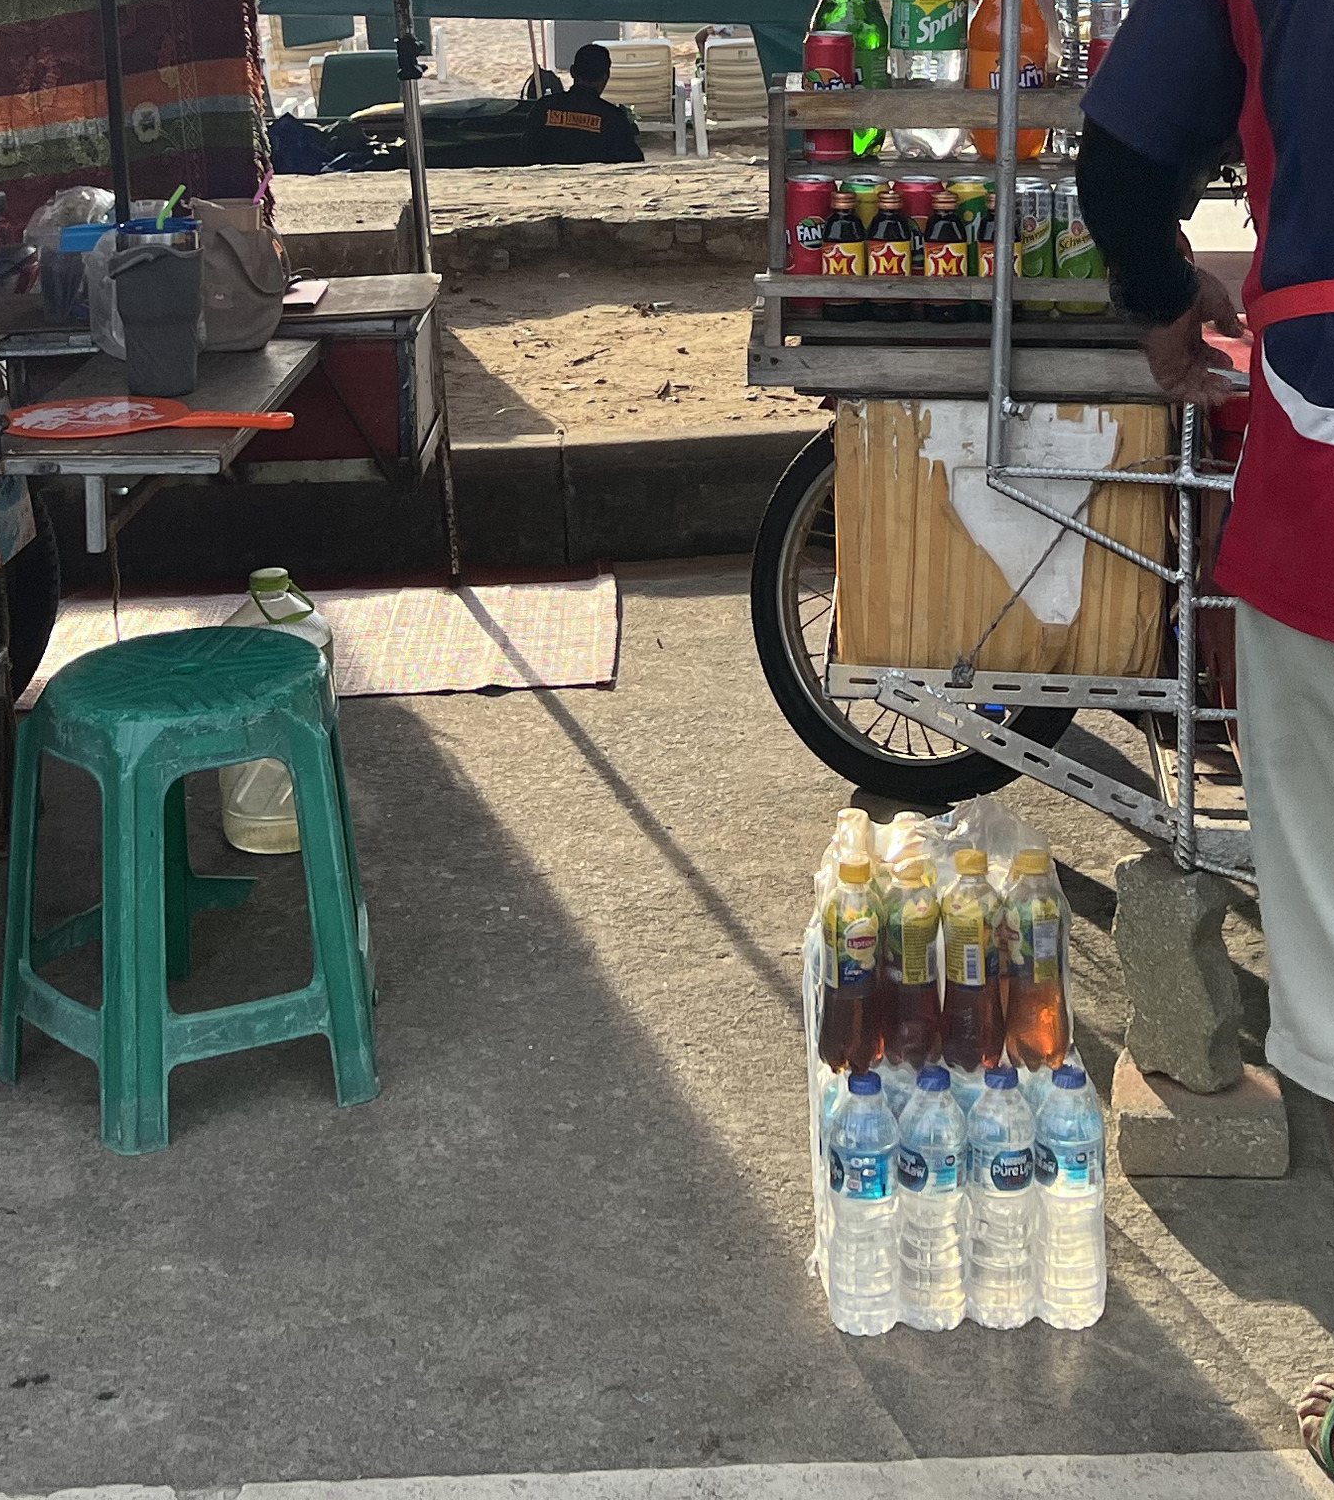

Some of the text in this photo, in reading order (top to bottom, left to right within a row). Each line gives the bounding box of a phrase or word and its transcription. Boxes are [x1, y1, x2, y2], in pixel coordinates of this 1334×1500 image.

[917, 0, 965, 44] Sprite
[829, 257, 849, 275] M
[878, 257, 899, 274] M
[937, 257, 960, 275] M
[991, 1165, 1016, 1177] Pure
